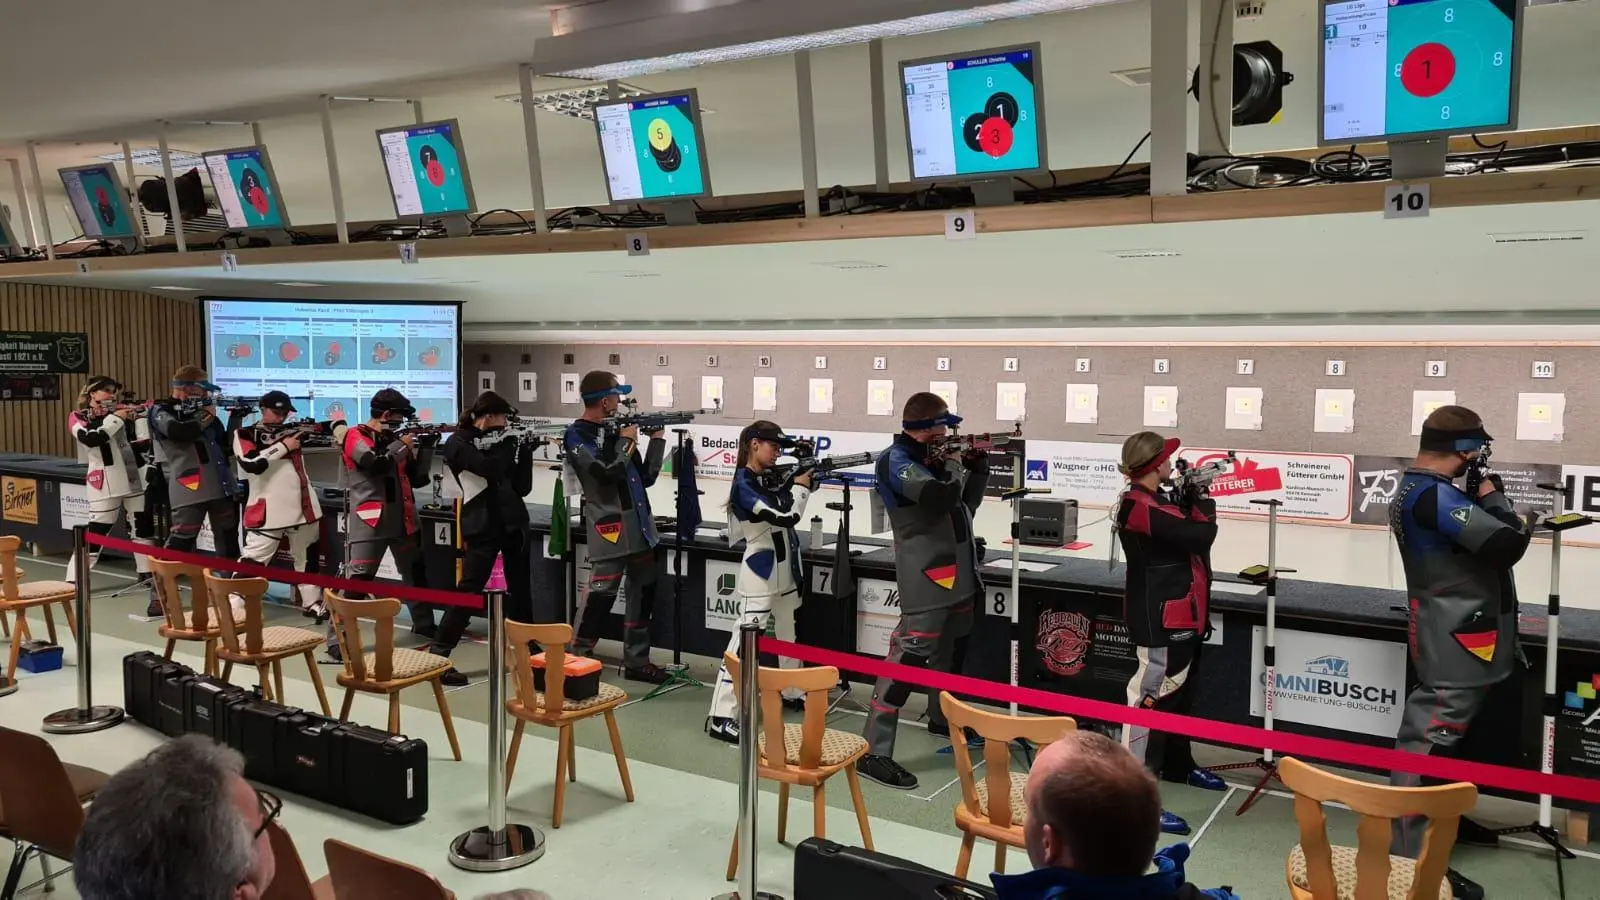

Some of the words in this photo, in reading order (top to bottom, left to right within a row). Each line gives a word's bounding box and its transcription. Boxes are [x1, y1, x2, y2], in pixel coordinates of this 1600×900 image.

[1444, 7, 1454, 23] 8
[1493, 51, 1503, 66] 8
[1394, 63, 1402, 77] 8
[1422, 60, 1431, 79] 1
[986, 76, 994, 88] 8
[996, 104, 1004, 119] 1
[1440, 106, 1450, 120] 8
[656, 127, 664, 140] 5
[974, 124, 983, 140] 2
[991, 128, 1000, 144] 3
[1391, 192, 1424, 212] 10
[954, 217, 965, 232] 9
[632, 238, 642, 251] 8
[658, 355, 665, 364] 8
[708, 356, 715, 366] 9
[760, 357, 769, 366] 10
[818, 359, 823, 368] 1
[876, 359, 883, 369] 2
[939, 360, 946, 369] 3
[1007, 360, 1014, 370] 4
[1079, 361, 1086, 371] 5
[1158, 362, 1165, 371] 6
[1242, 362, 1249, 372] 7
[1332, 363, 1339, 374] 8
[1432, 364, 1439, 375] 9
[1535, 365, 1551, 375] 10
[1053, 461, 1090, 471] Wagner
[1094, 463, 1116, 473] oHG
[1287, 461, 1331, 470] Schreinerei
[1287, 470, 1318, 479] Fütterer
[1319, 473, 1345, 481] GmbH
[439, 526, 447, 543] 4
[819, 571, 830, 592] 7
[993, 591, 1006, 614] 8
